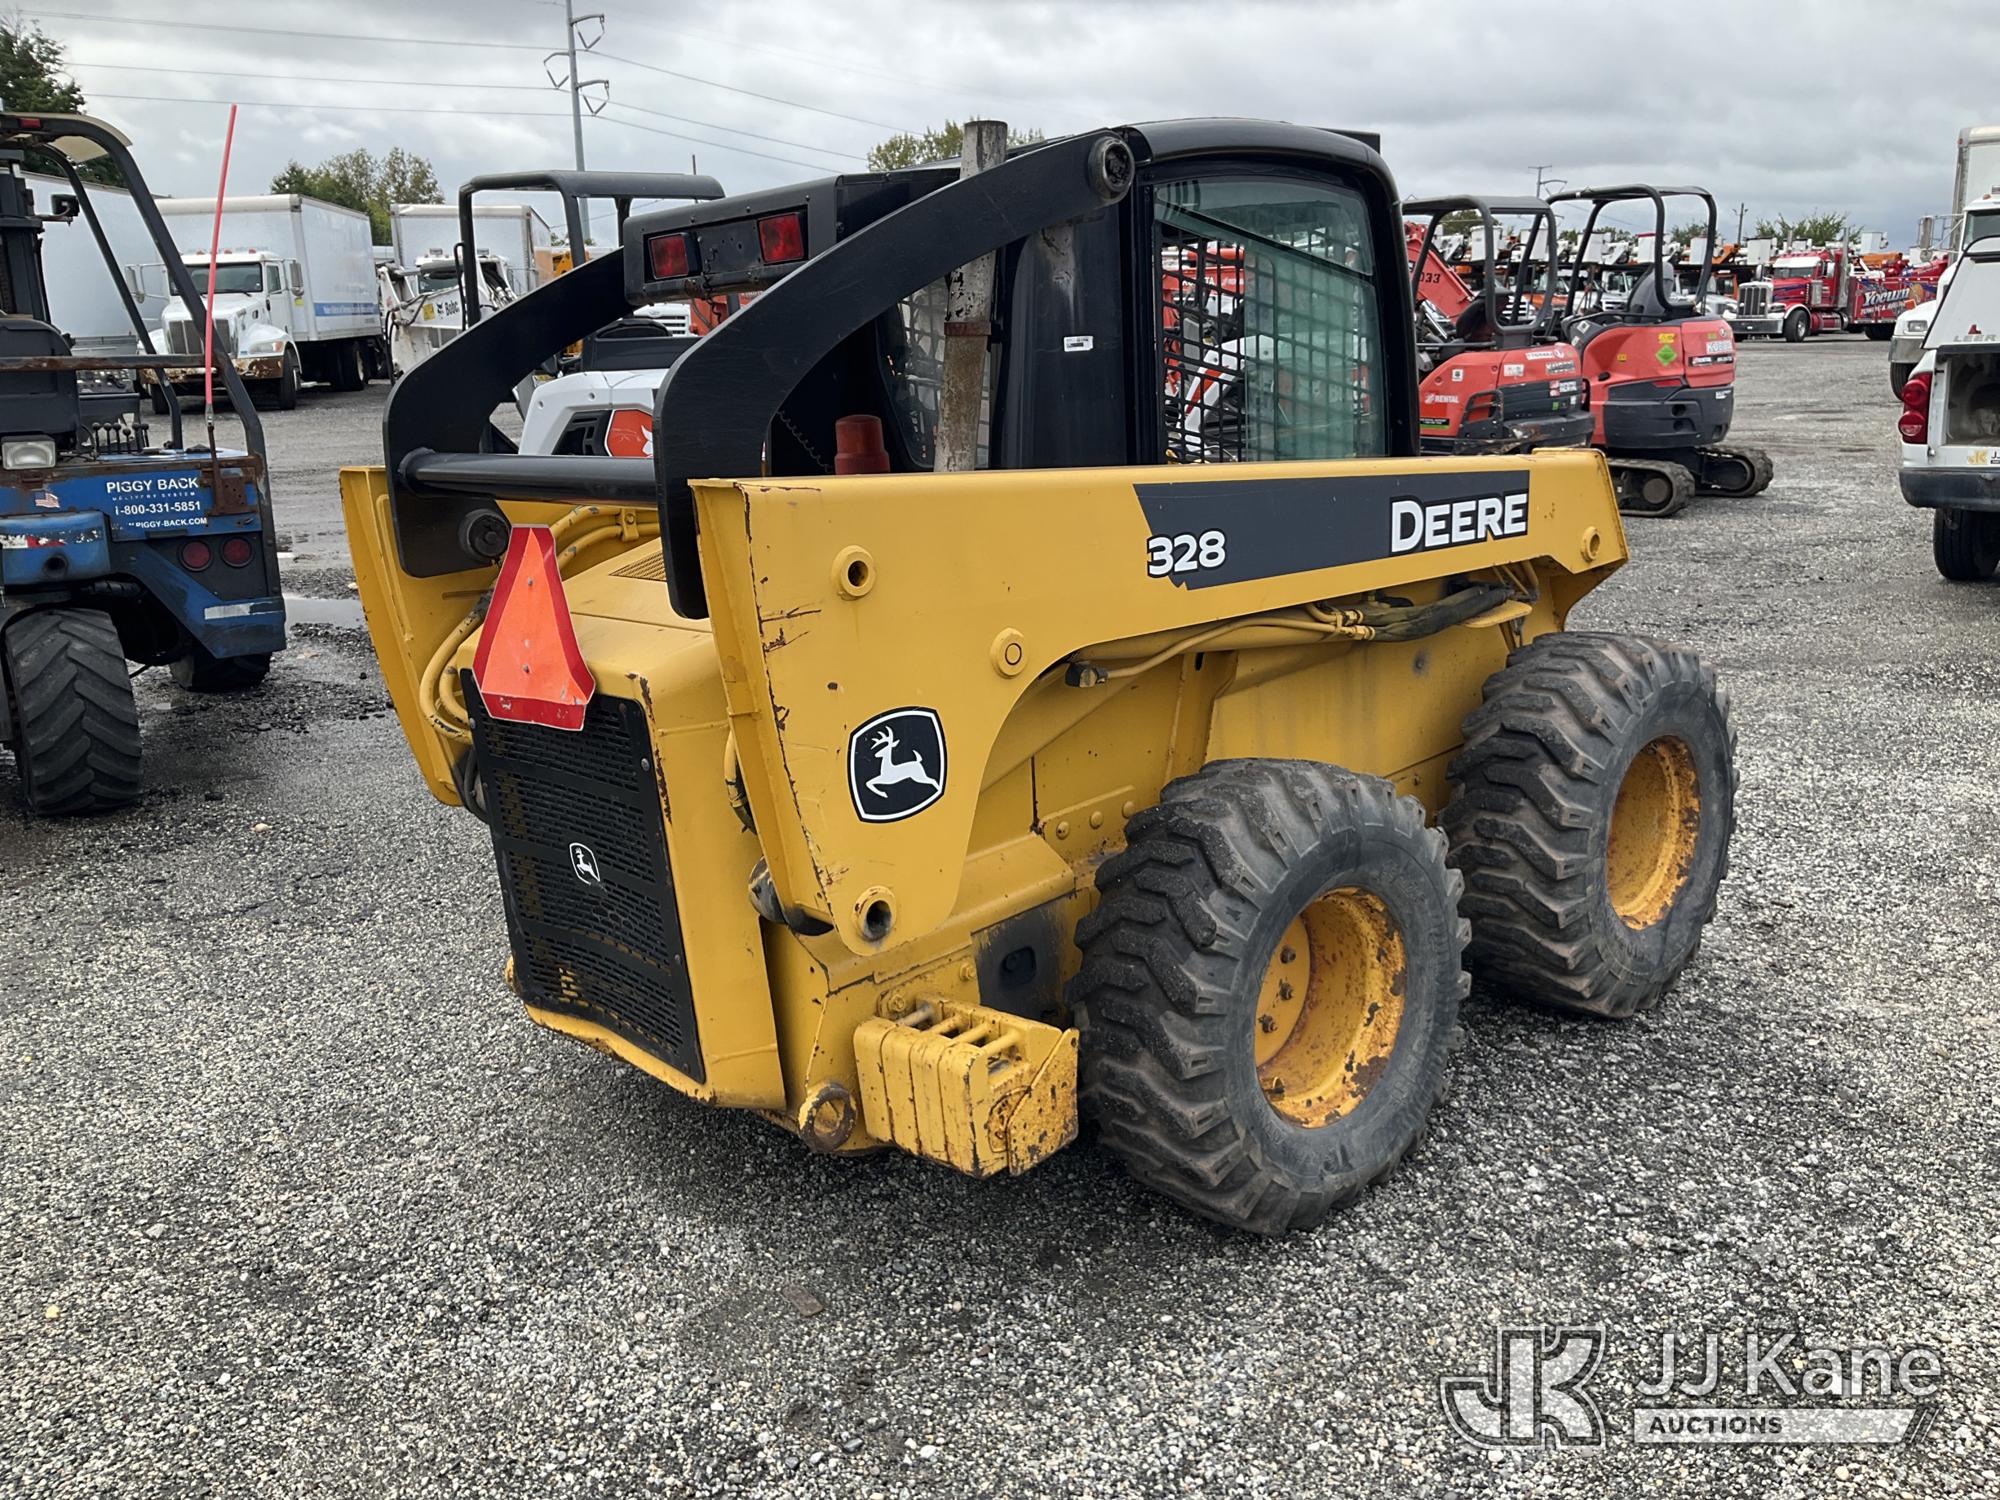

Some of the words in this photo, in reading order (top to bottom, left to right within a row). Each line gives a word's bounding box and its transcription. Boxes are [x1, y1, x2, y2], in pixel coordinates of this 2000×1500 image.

[1953, 334, 1997, 343] LEER
[106, 480, 152, 493] PIGGY
[157, 477, 199, 490] BACK
[115, 501, 201, 515] 1-800-331-5851
[1390, 493, 1529, 554] DEERE
[1147, 530, 1226, 577] 328
